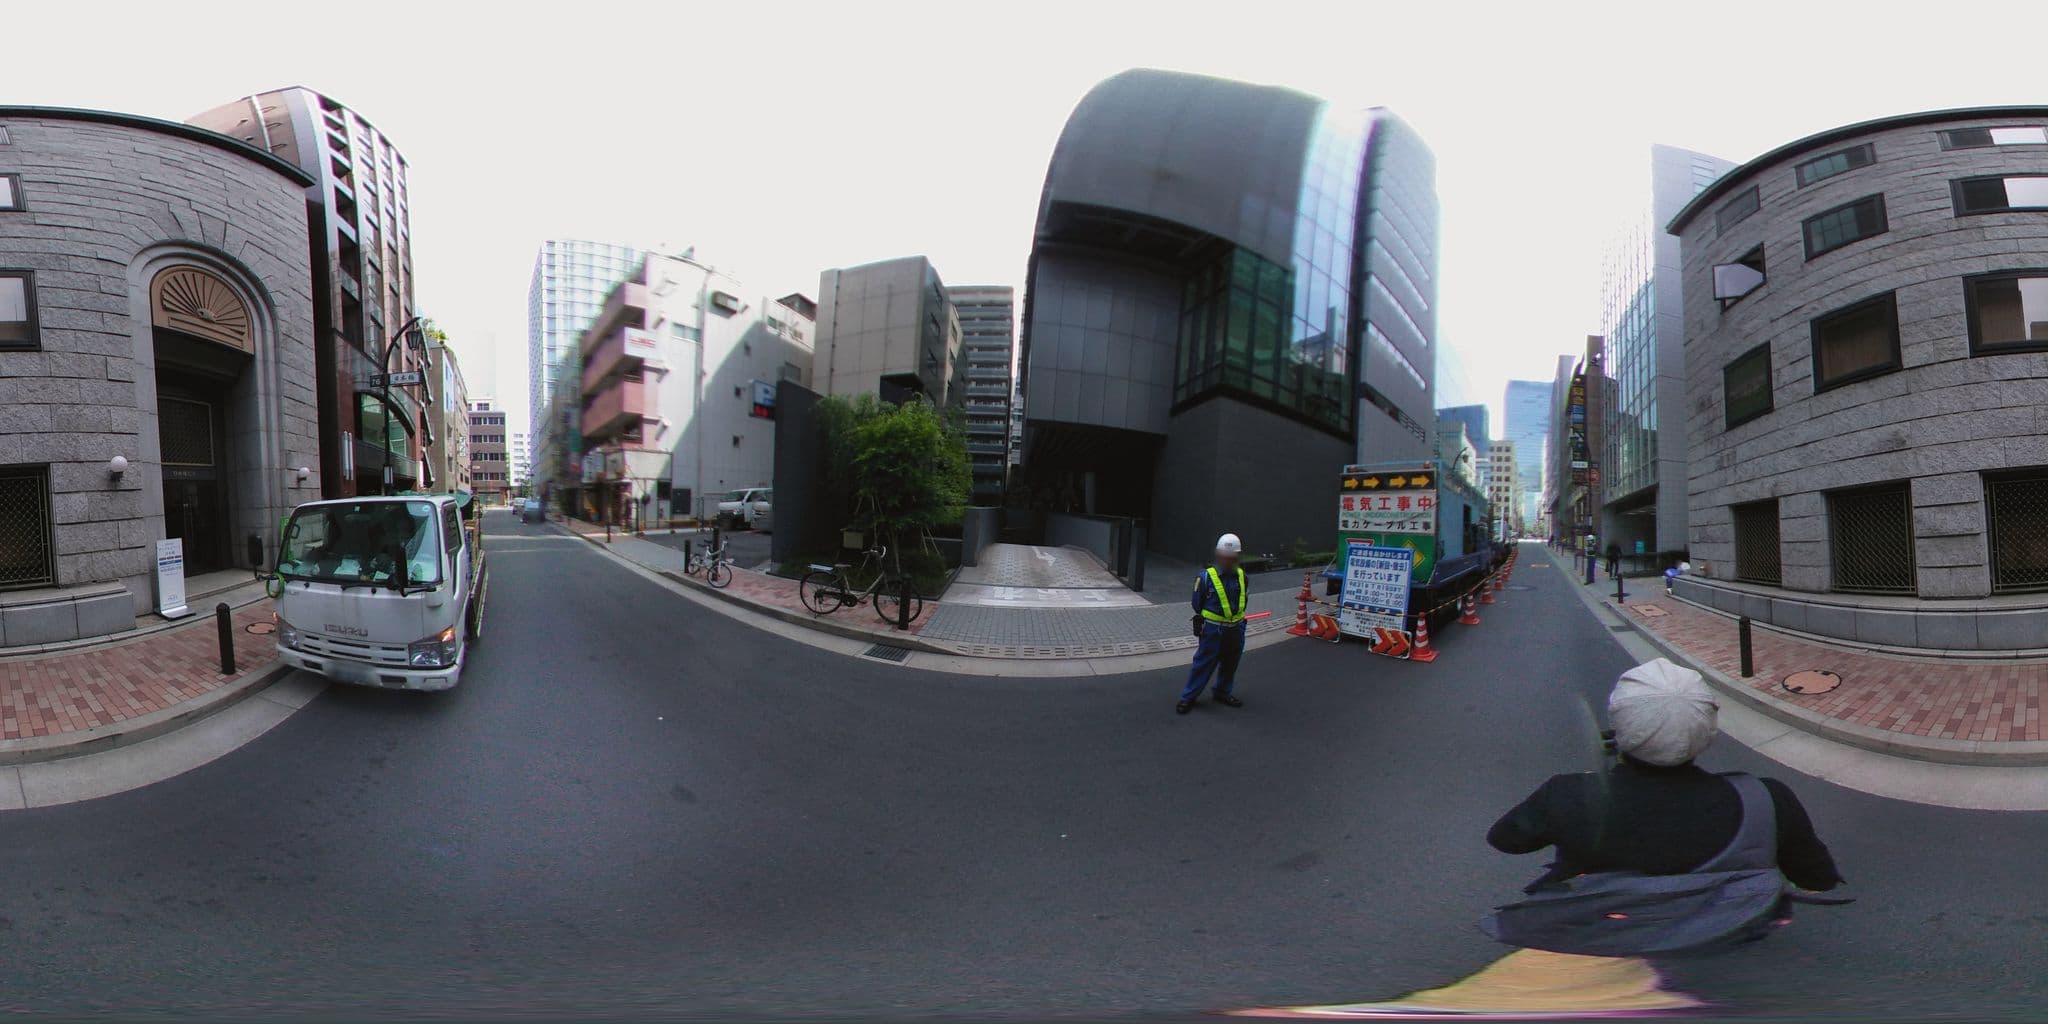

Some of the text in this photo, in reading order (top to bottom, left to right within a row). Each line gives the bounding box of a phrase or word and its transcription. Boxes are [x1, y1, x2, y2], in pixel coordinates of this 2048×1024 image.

[1342, 495, 1433, 512] 電気工事中
[1341, 520, 1432, 531] 電力ケーブル工事
[1353, 570, 1401, 583] を行っています
